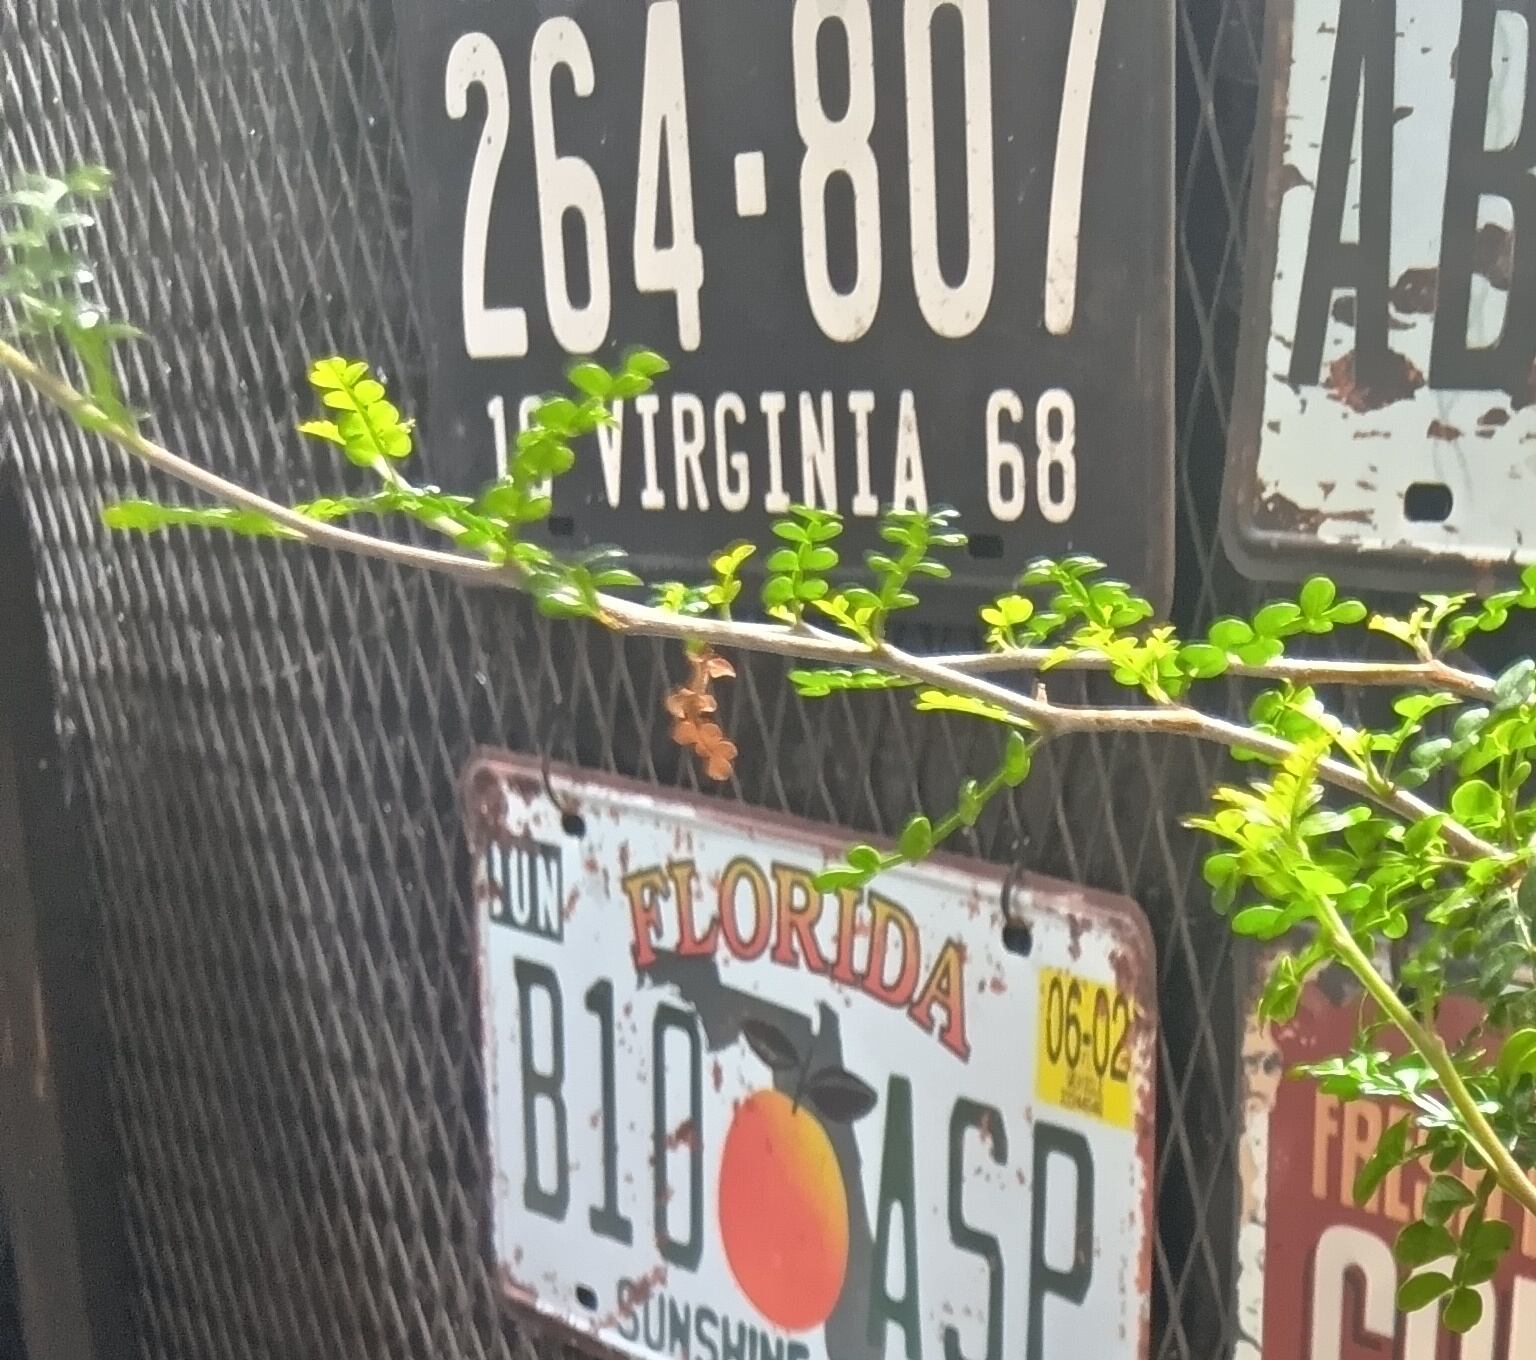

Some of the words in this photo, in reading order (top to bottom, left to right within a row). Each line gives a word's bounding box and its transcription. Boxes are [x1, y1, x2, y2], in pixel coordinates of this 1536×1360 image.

[597, 387, 928, 517] VIRGINIA
[985, 388, 1078, 524] 68
[621, 855, 970, 1060] FLORIDA
